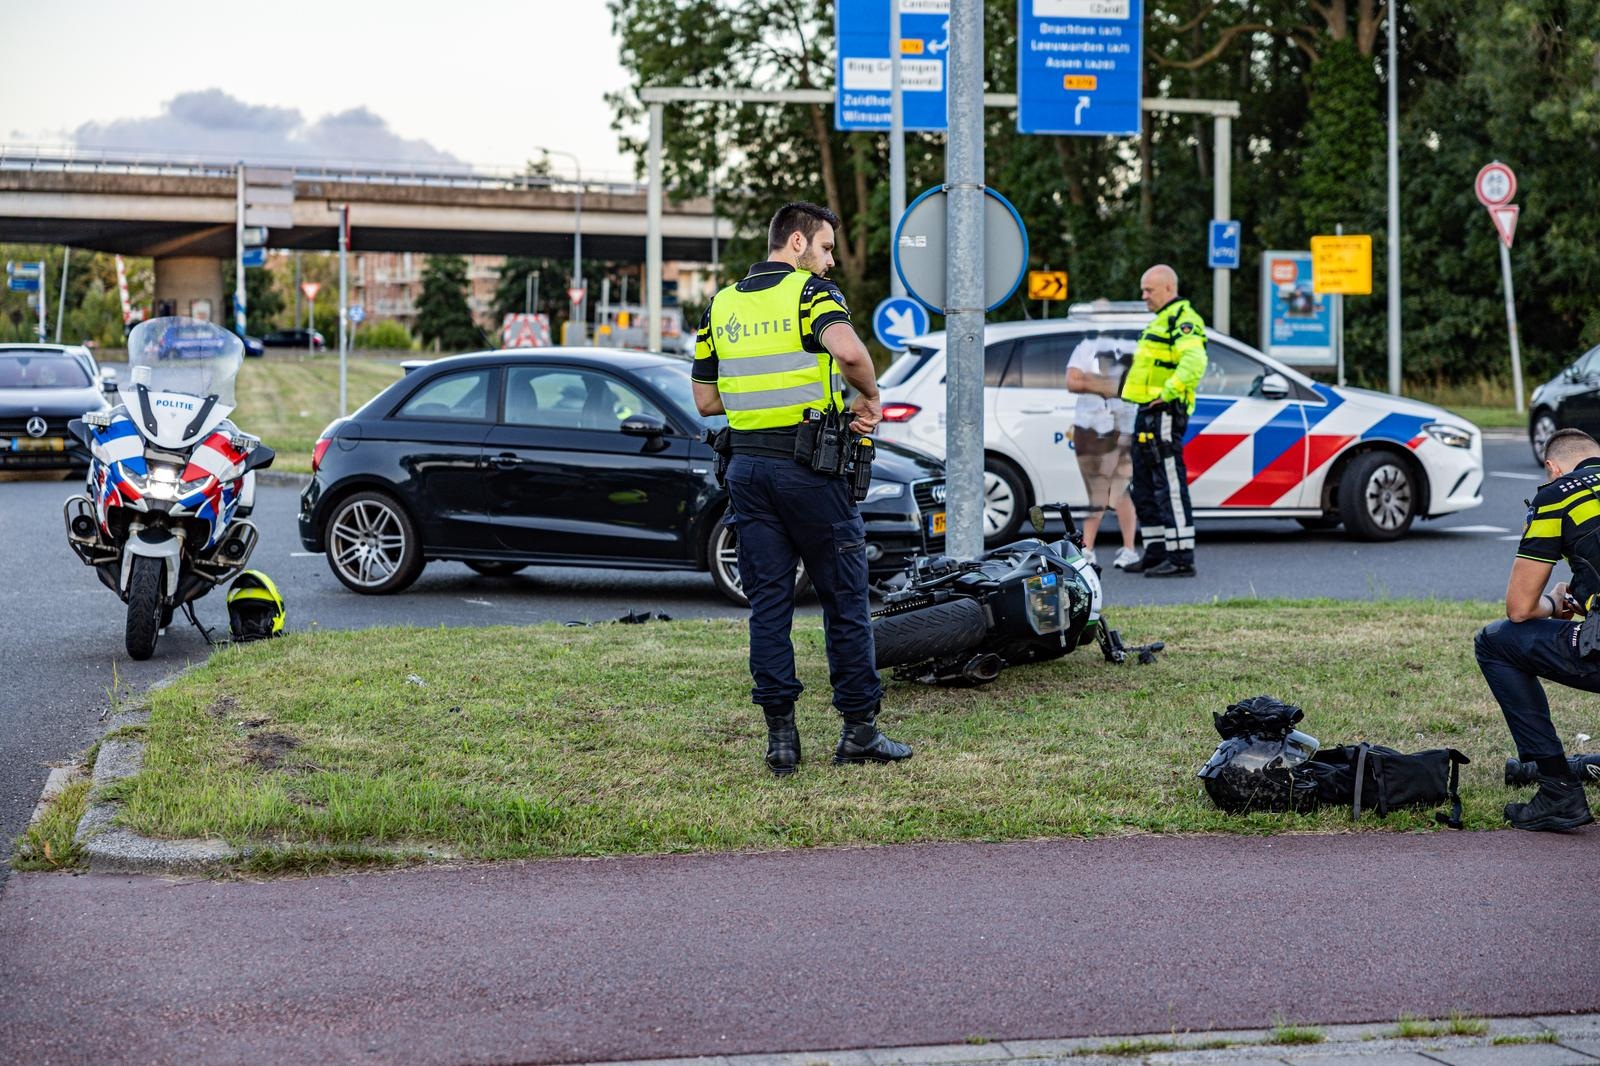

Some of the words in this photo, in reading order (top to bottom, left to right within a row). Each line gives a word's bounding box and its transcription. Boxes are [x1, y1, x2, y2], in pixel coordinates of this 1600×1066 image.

[1030, 39, 1104, 51] Leeuwarden
[716, 316, 791, 342] POLITIE
[155, 398, 194, 412] POLITIE
